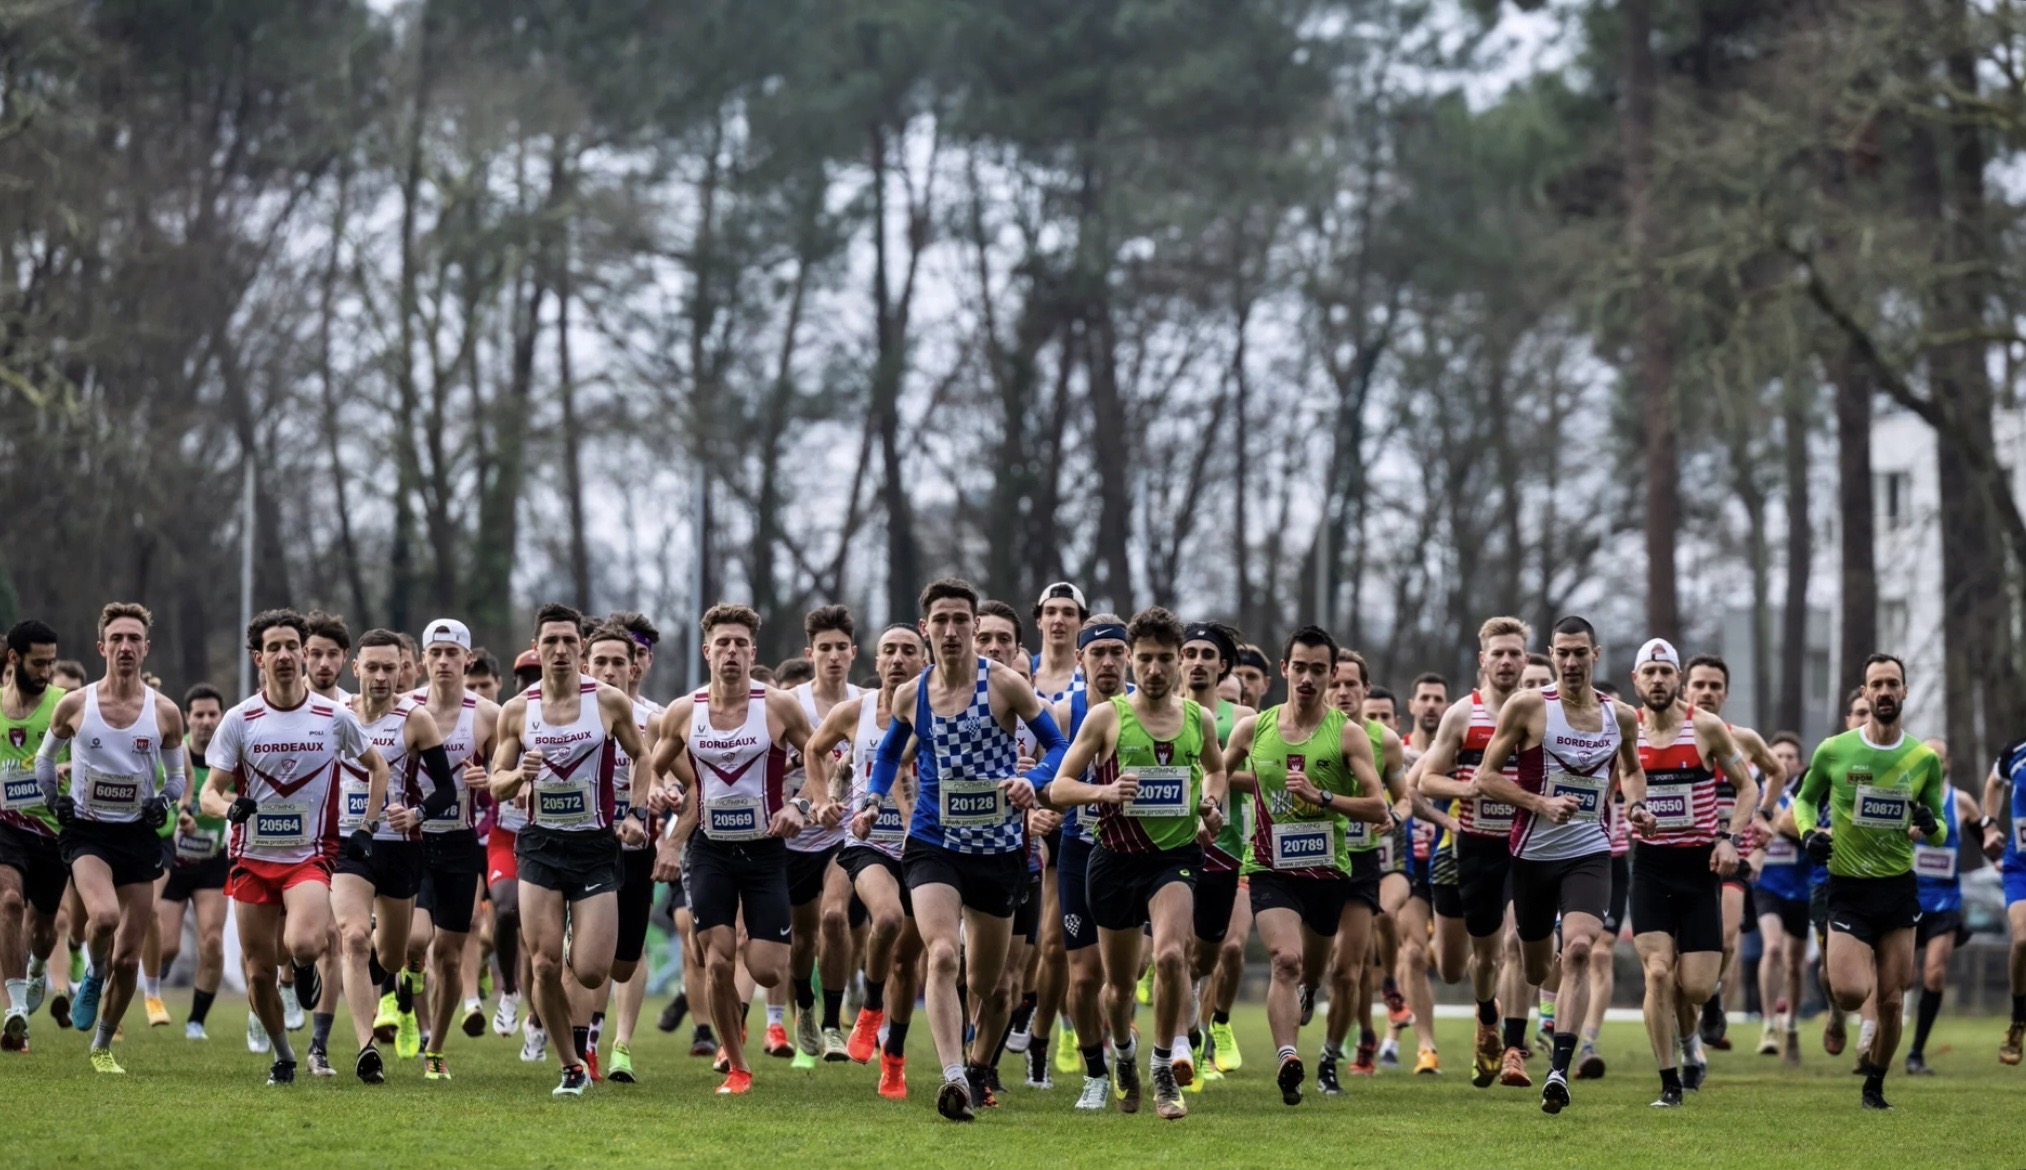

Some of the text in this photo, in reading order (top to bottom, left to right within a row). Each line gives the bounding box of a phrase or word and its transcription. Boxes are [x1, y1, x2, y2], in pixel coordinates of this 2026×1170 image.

[535, 731, 592, 744] BORDEAUX
[699, 737, 757, 748] BORDEAUX
[1556, 736, 1611, 748] BORDEAUX
[254, 742, 324, 753] BORDEAUX
[96, 785, 134, 798] 60582
[1136, 785, 1180, 799] 20797
[542, 796, 581, 809] 20572
[951, 796, 994, 811] 20128
[1646, 799, 1683, 812] 60550
[1864, 801, 1902, 815] 20873
[260, 819, 299, 832] 20564
[714, 813, 752, 826] 20569
[1283, 838, 1324, 852] 20789
[1279, 858, 1331, 867] www.protiming.fr
